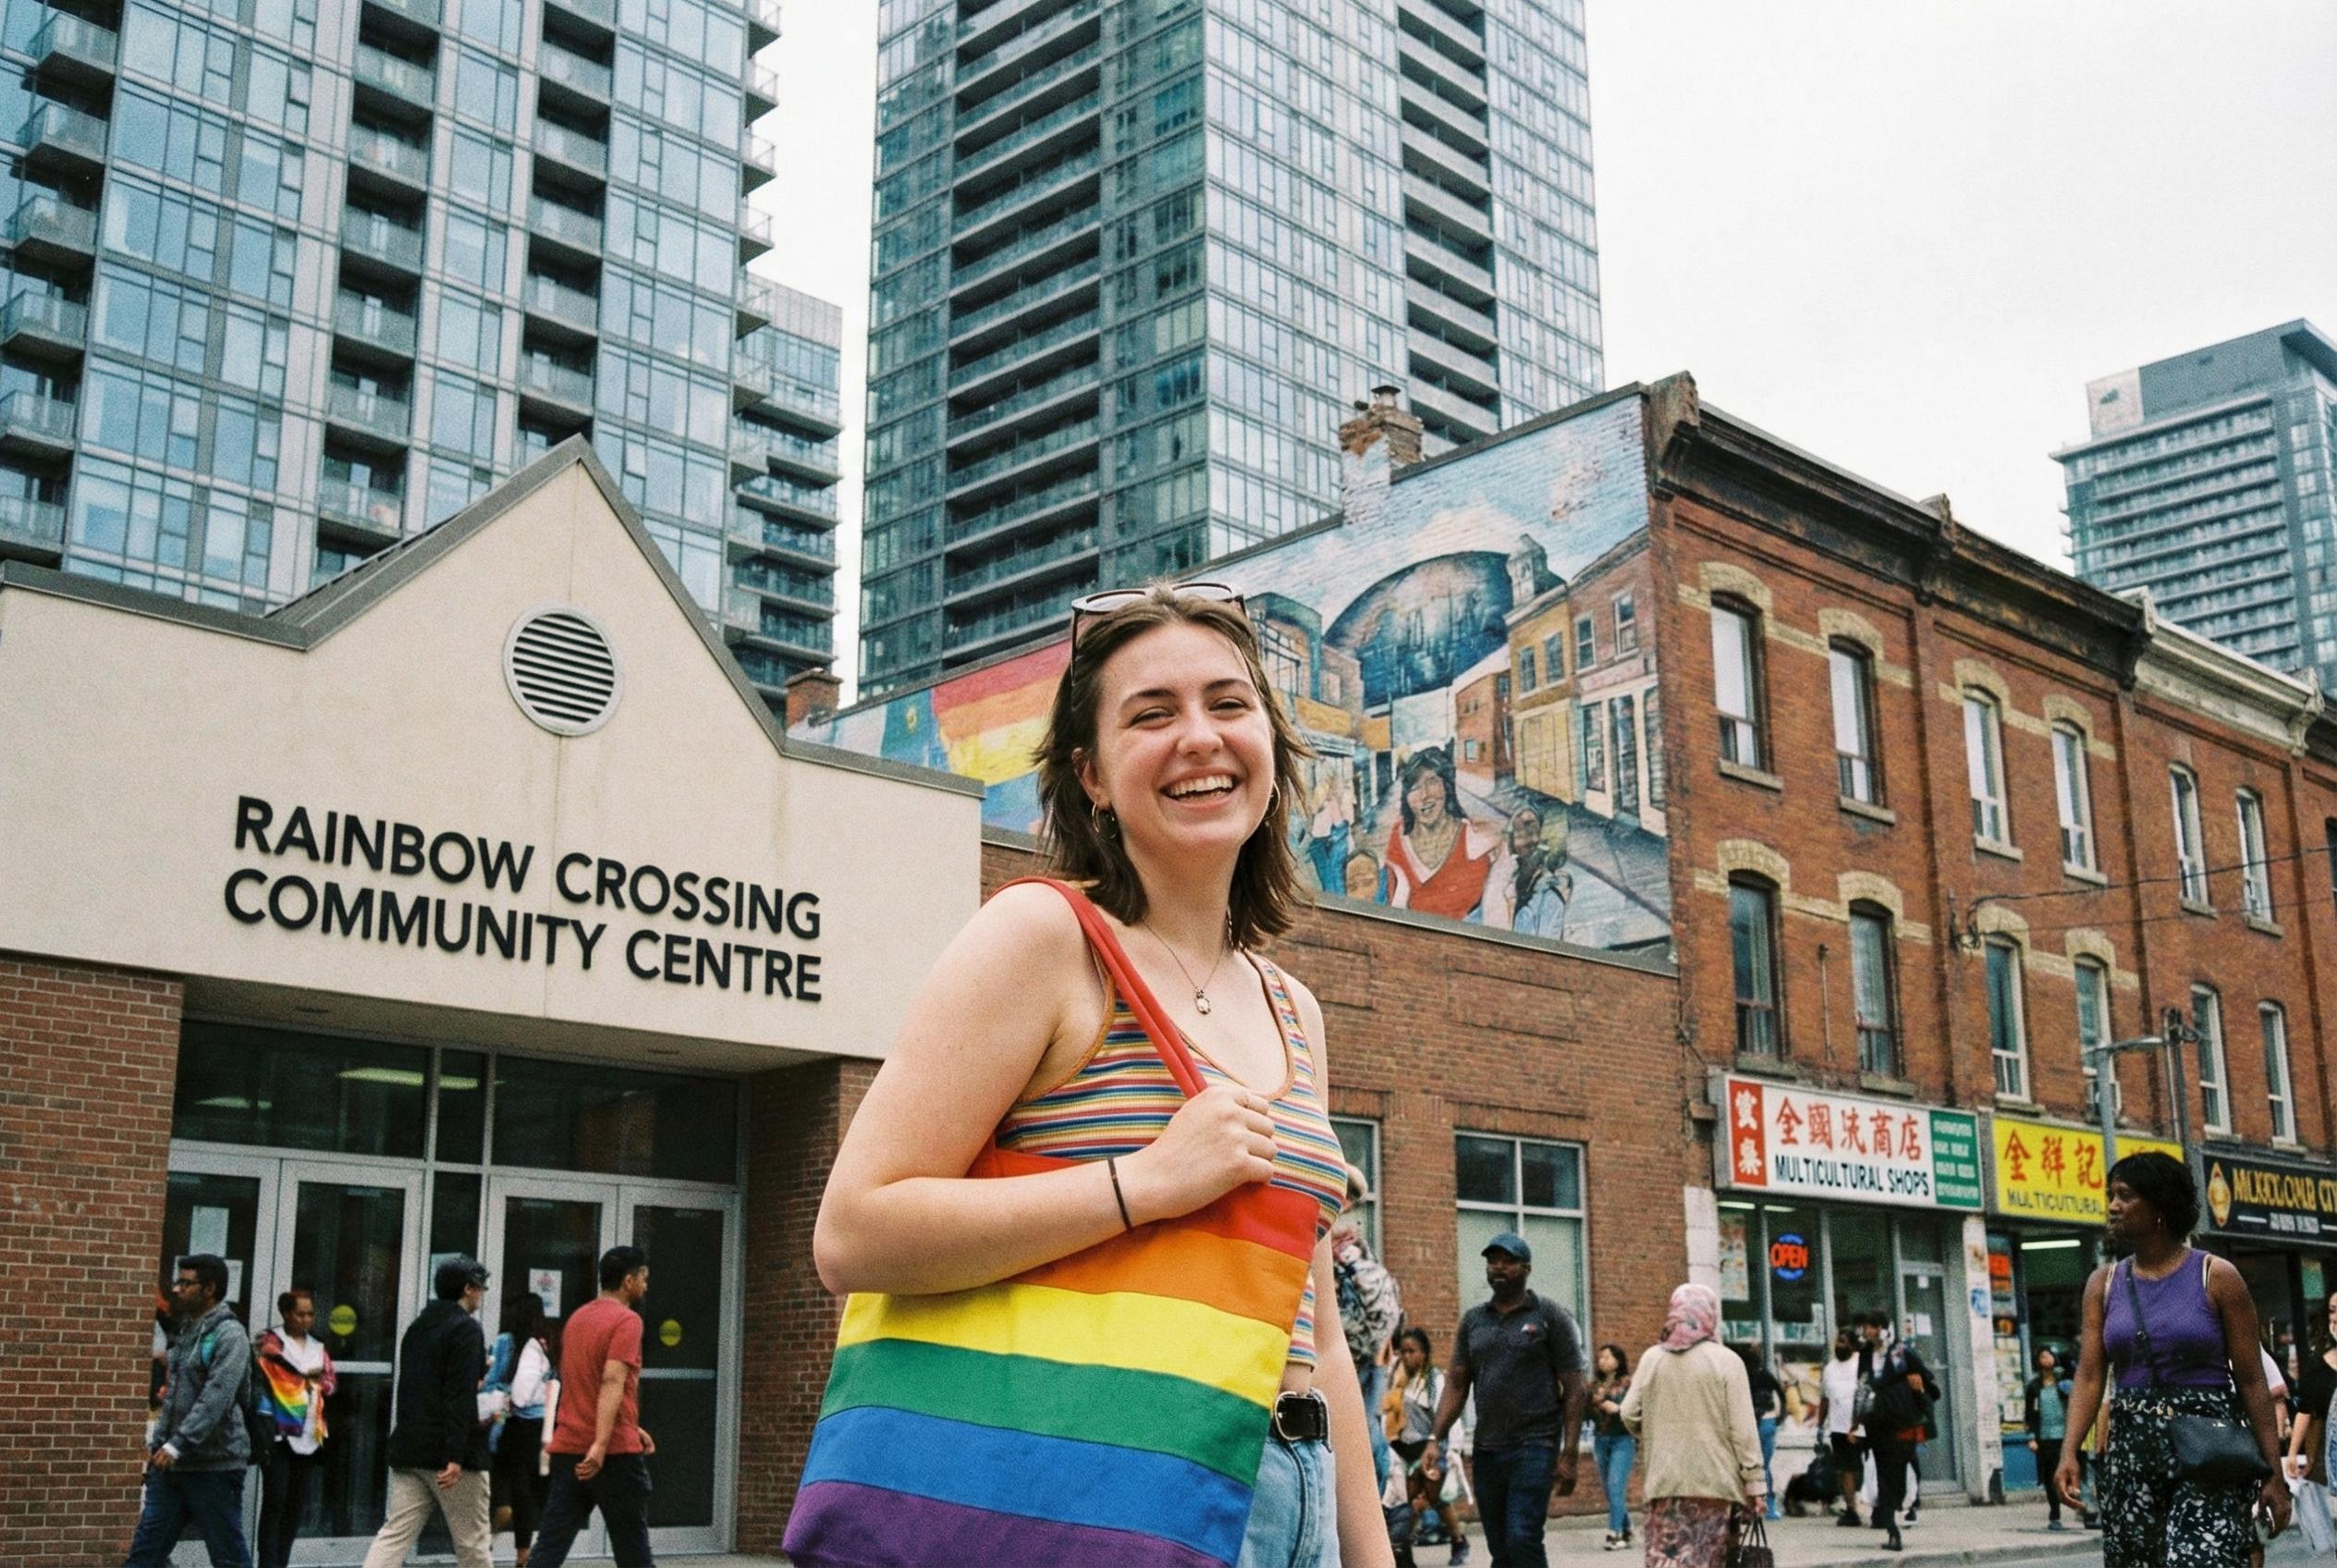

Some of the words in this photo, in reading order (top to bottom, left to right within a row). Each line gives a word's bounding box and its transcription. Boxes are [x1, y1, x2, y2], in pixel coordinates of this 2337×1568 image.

[234, 795, 535, 894] RAINBOW
[556, 852, 821, 941] CROSSING
[224, 868, 607, 971] COMMUNITY
[626, 929, 823, 1003] CENTRE
[1775, 1154, 1884, 1193] MULTICULTURAL
[1887, 1167, 1929, 1197] SHOPS
[1770, 1243, 1809, 1269] OPEN
